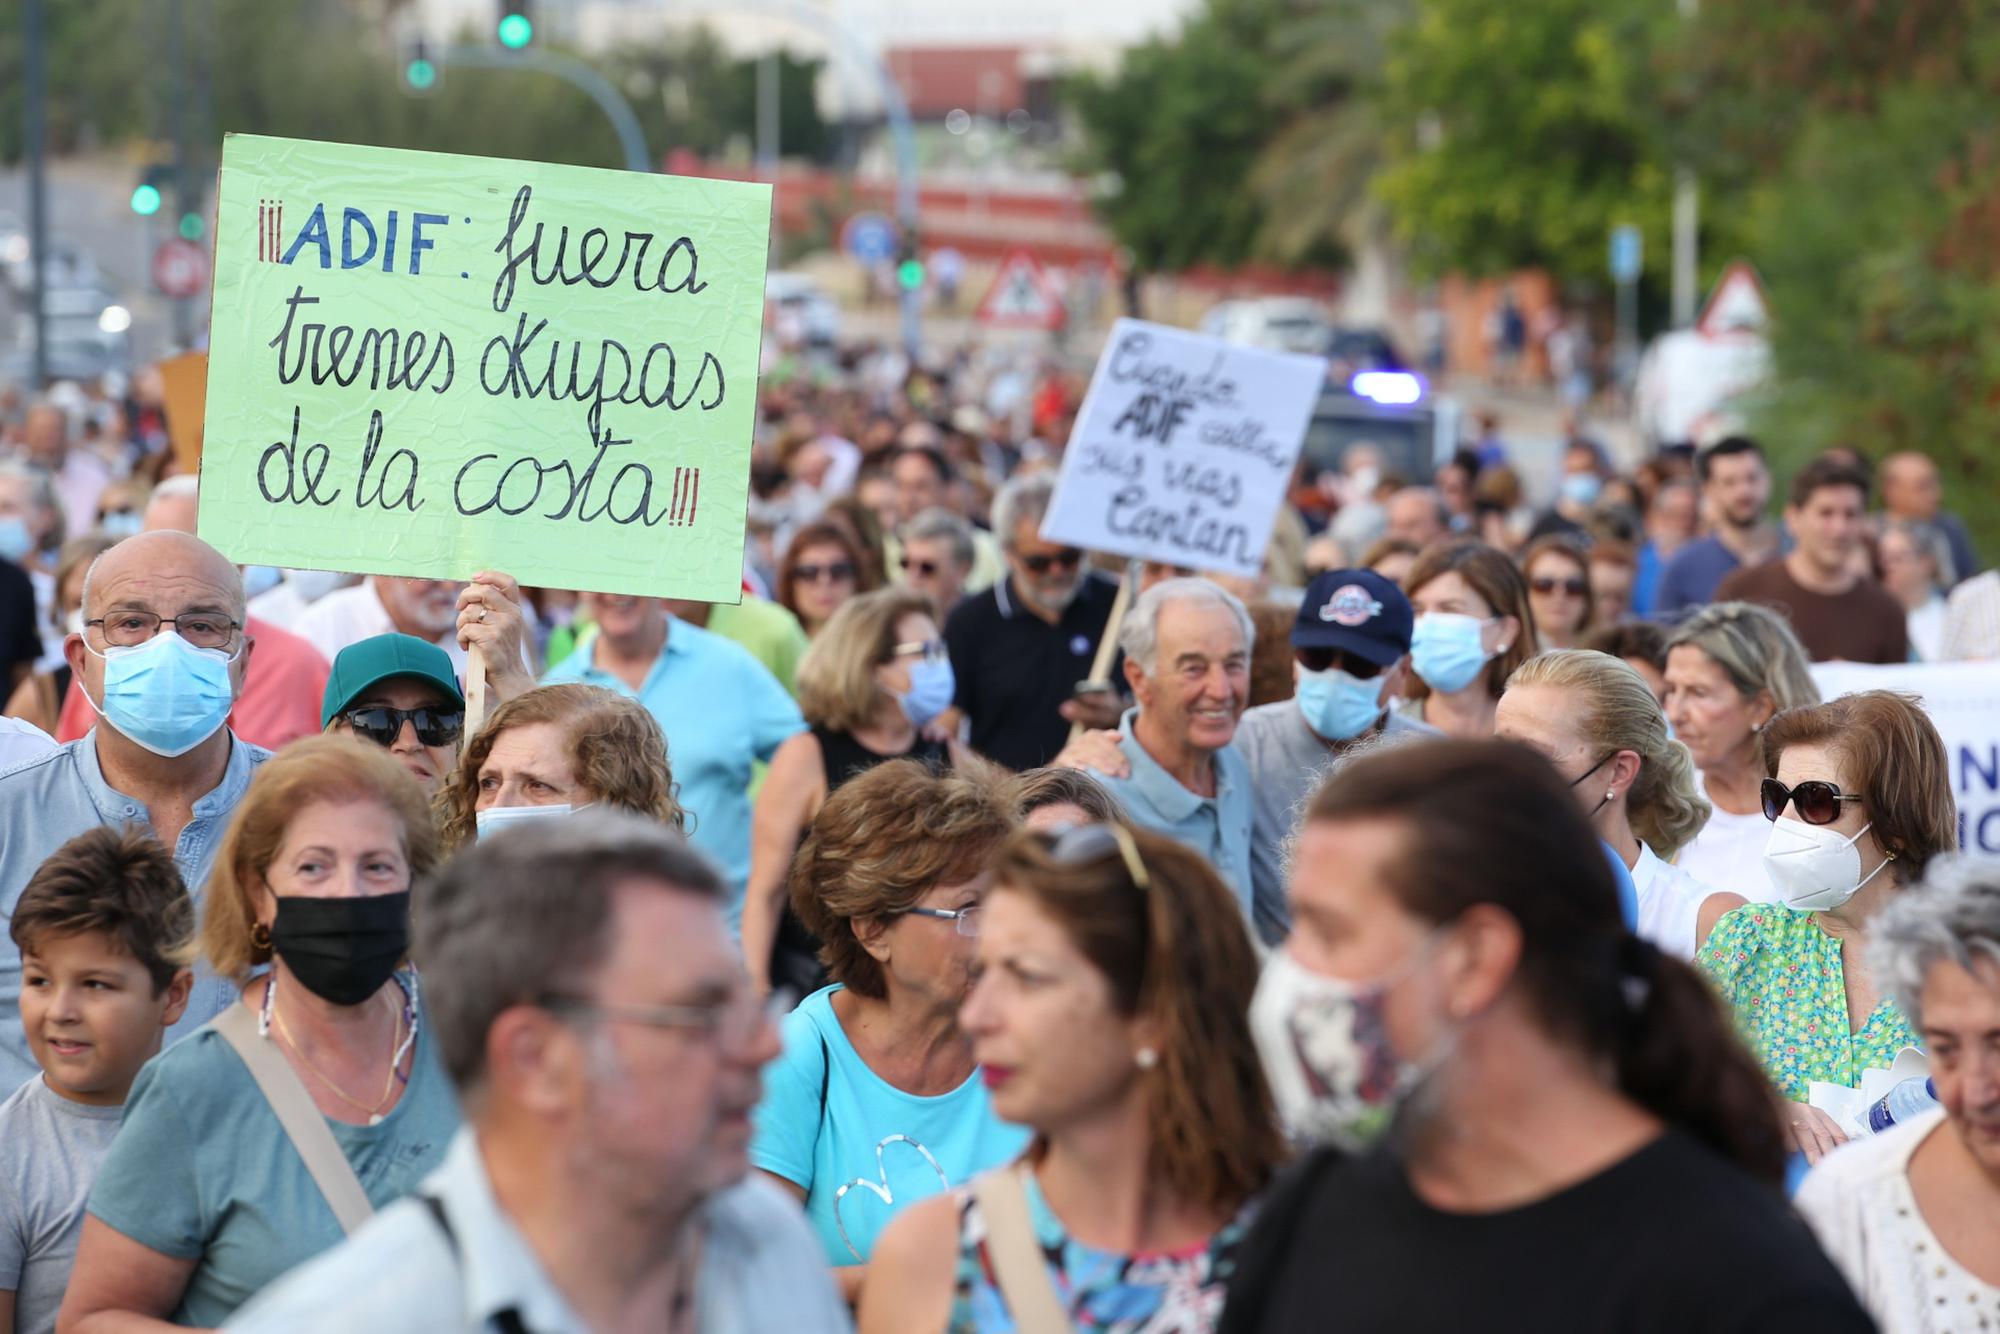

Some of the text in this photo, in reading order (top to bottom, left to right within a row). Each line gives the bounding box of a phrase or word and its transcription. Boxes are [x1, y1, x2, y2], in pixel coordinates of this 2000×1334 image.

[492, 184, 708, 312] fuera
[269, 285, 455, 394] trenes
[257, 405, 700, 527] de la costa!!!
[1111, 393, 1193, 446] ADIF
